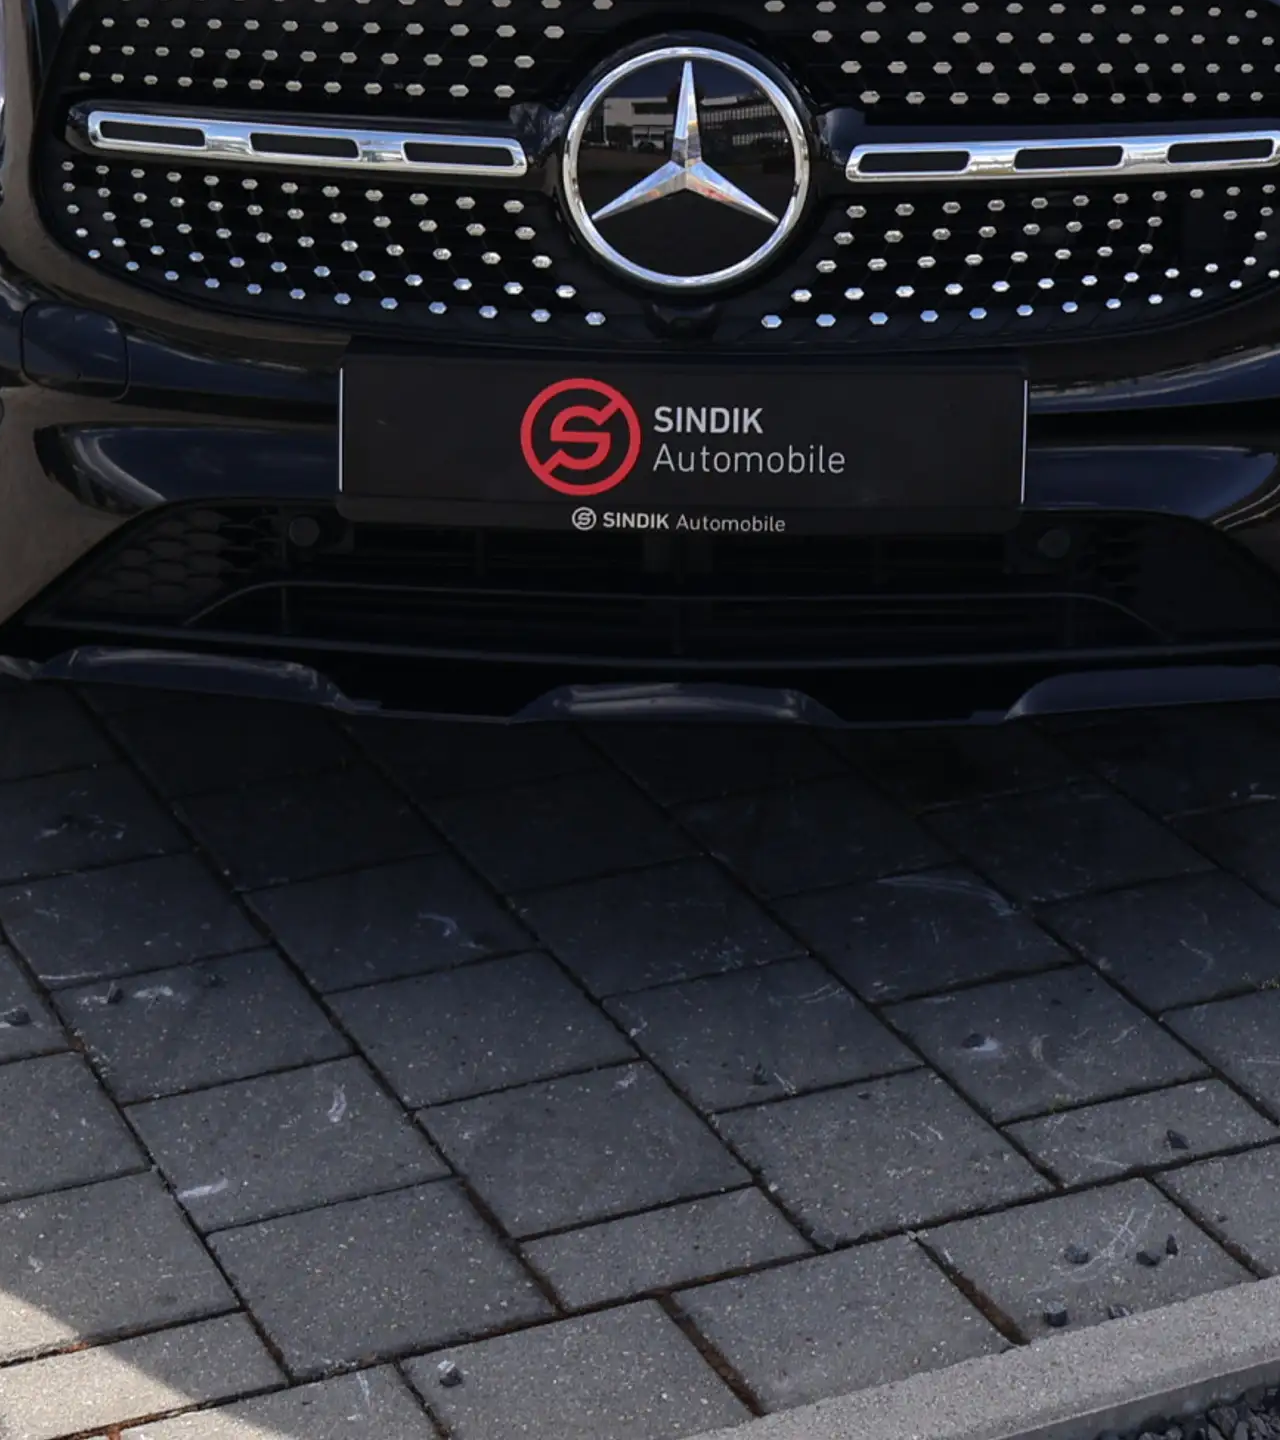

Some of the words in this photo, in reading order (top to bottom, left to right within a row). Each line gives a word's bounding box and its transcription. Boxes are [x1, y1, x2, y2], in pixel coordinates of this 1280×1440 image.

[652, 405, 765, 435] SINDIK
[651, 442, 847, 474] Automobile
[602, 511, 670, 530] SINDIK
[675, 513, 786, 533] Automobile
